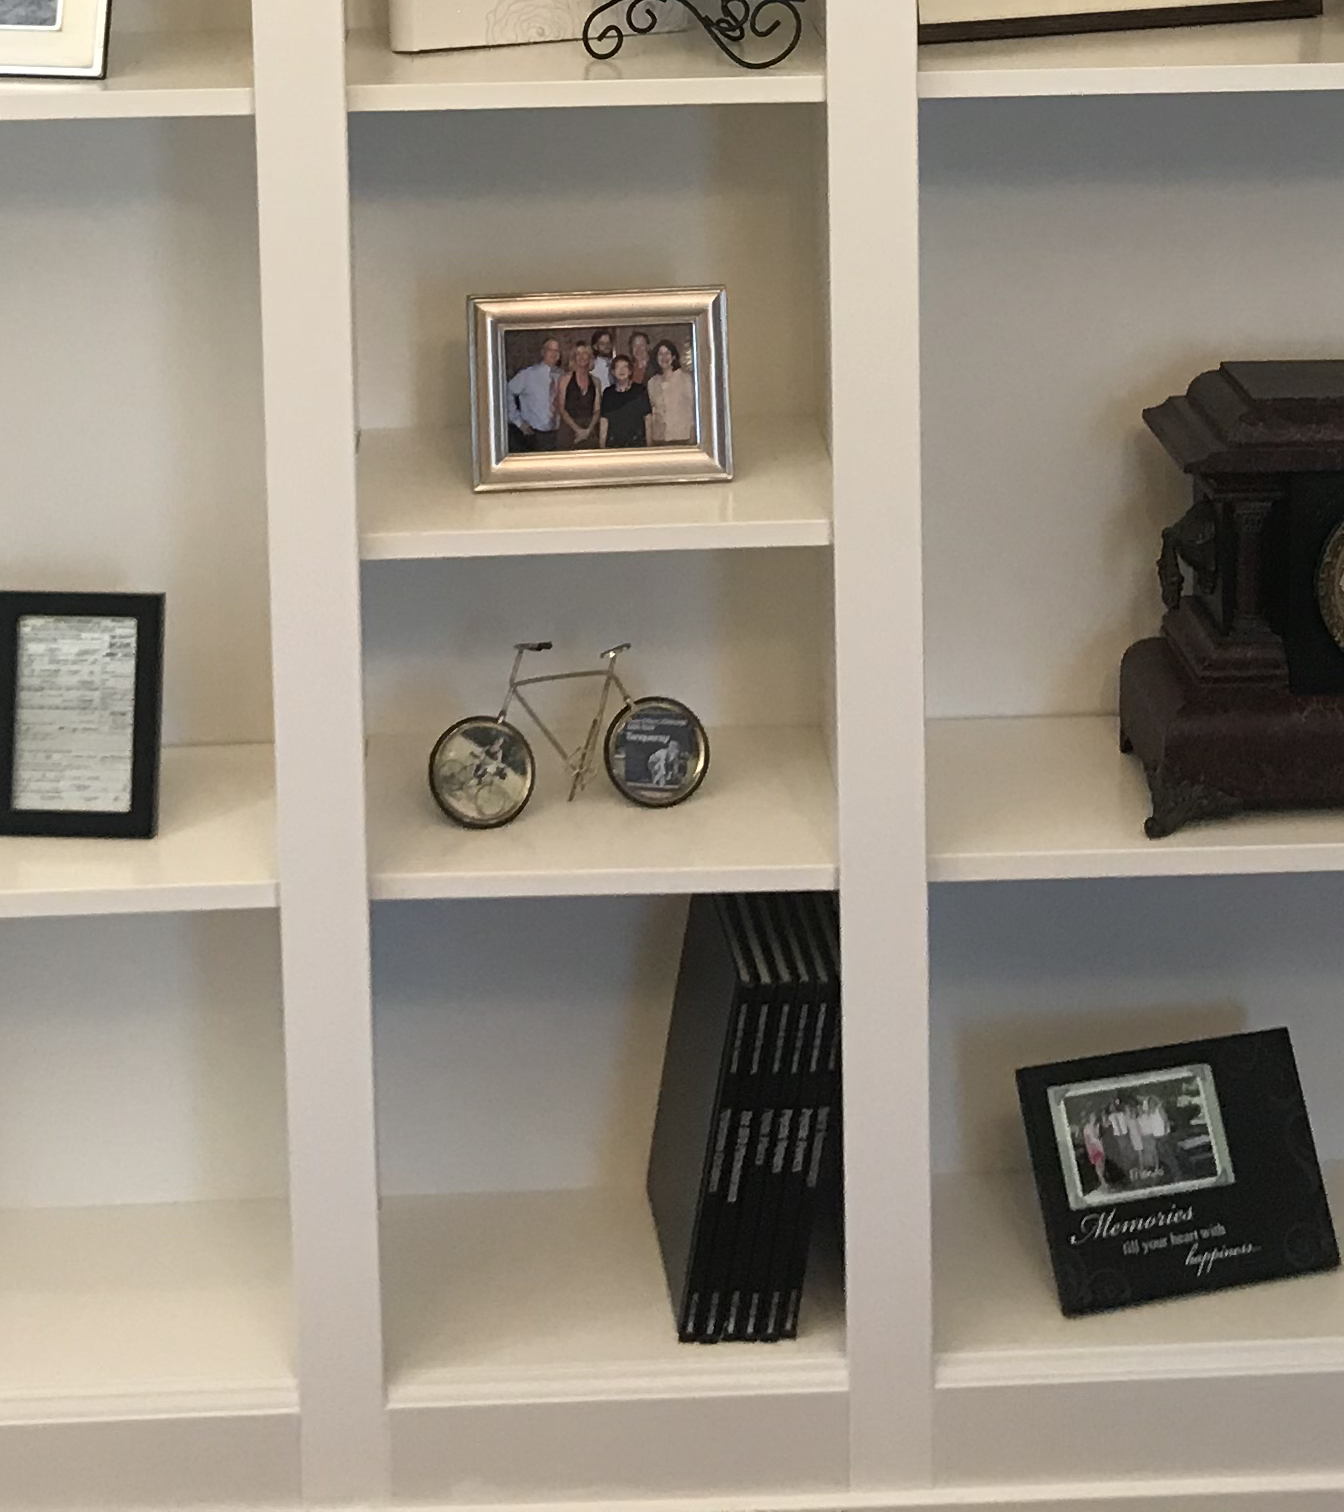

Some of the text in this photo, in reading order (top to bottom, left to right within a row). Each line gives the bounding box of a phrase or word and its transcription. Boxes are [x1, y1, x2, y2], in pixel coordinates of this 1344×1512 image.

[1068, 1203, 1194, 1246] Memories
[1141, 1237, 1168, 1255] your
[1169, 1229, 1199, 1245] heart
[1199, 1222, 1227, 1239] with
